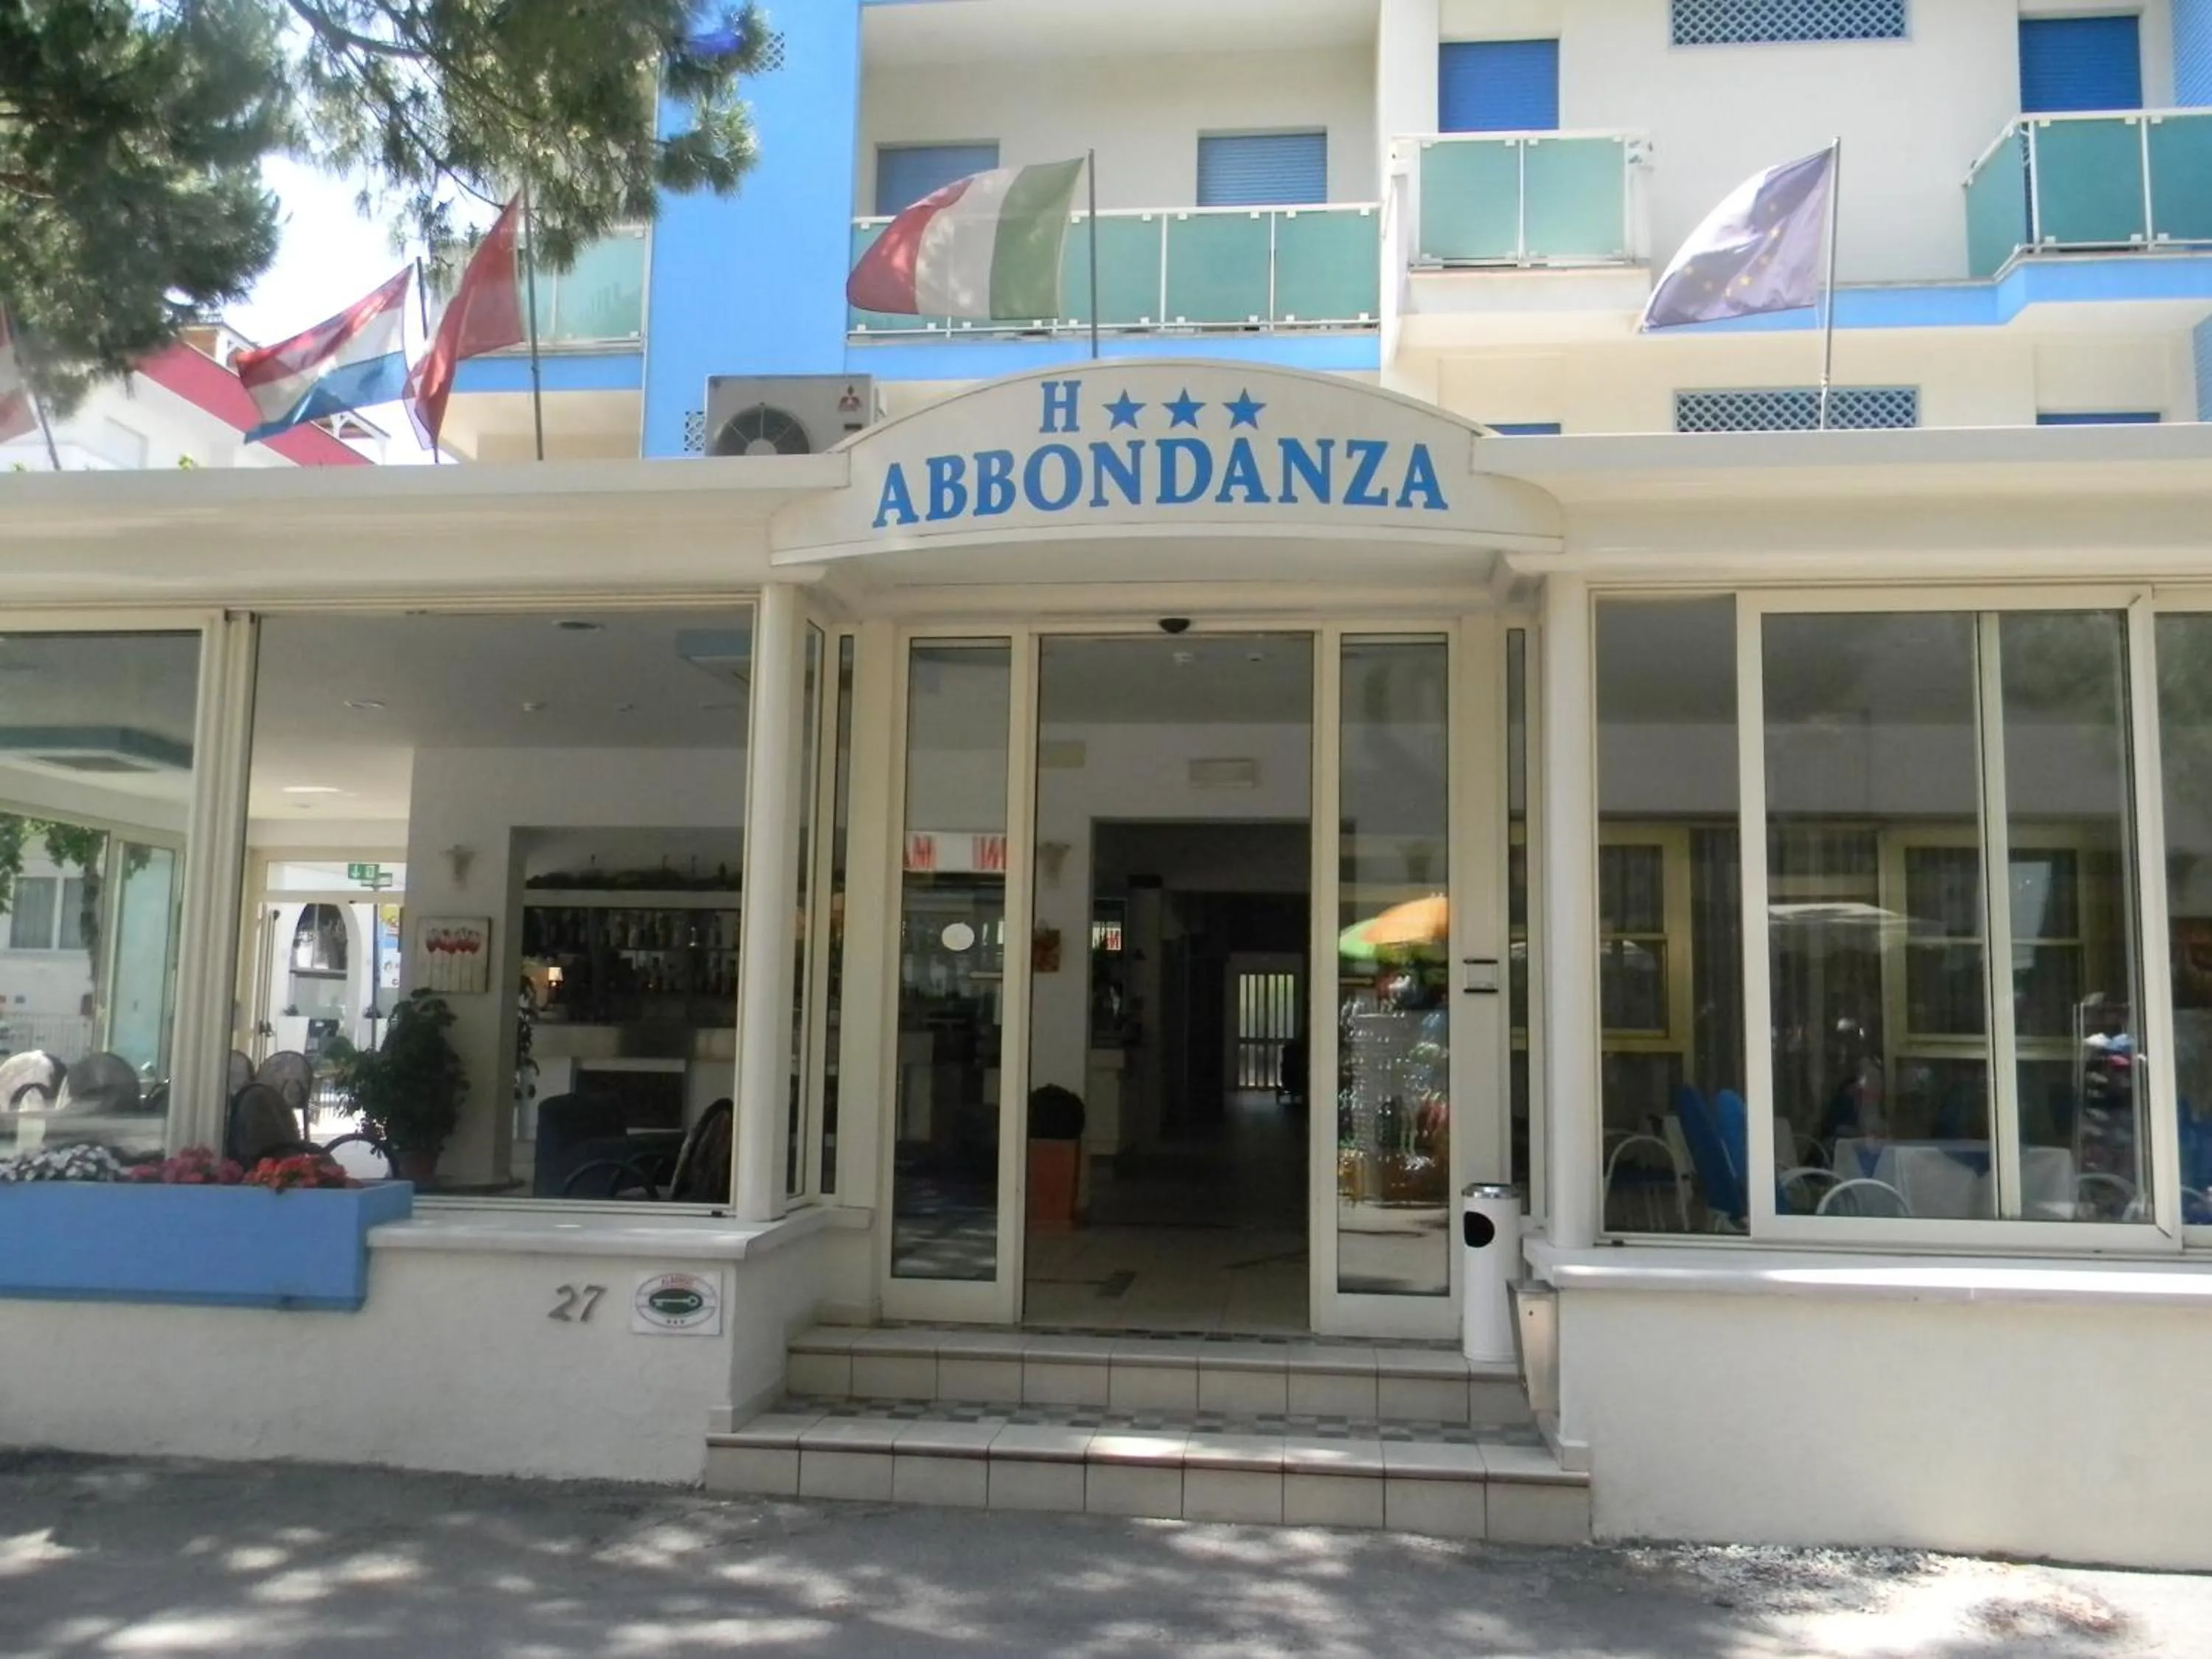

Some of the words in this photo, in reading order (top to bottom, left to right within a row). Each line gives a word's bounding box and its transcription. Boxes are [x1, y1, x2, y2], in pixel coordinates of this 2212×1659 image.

[1040, 380, 1081, 434] H
[873, 437, 1449, 529] ABBONDANZA
[547, 1282, 607, 1324] 27
